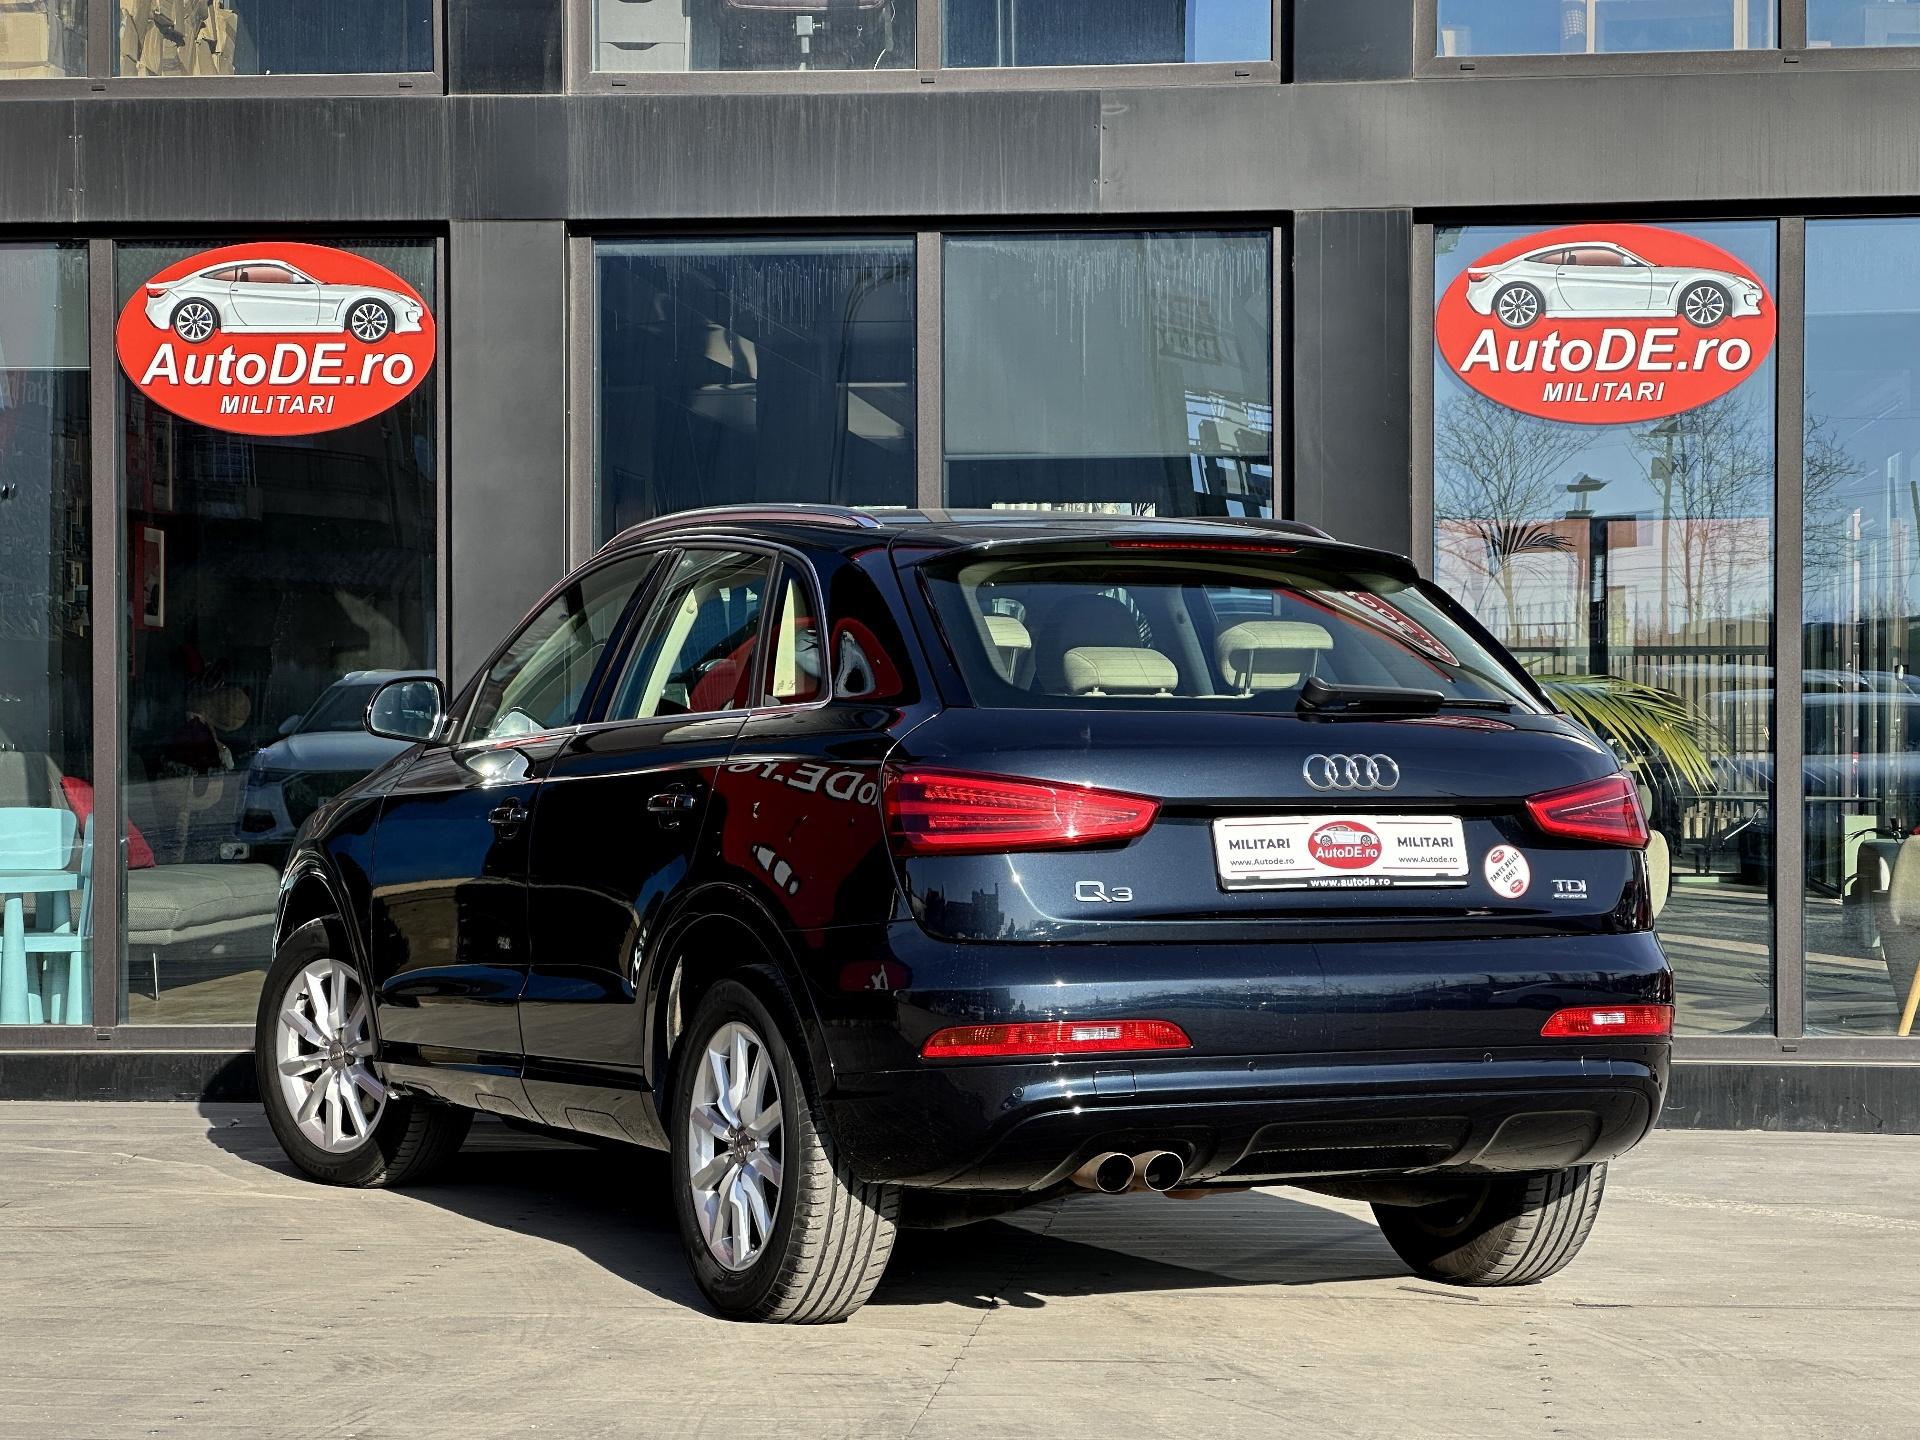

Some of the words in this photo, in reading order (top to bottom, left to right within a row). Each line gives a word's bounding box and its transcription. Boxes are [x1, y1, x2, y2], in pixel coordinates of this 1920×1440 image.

[1459, 327, 1751, 373] AutoDE.ro
[140, 343, 415, 386] AutoDE.ro
[1542, 381, 1665, 402] MILITARI
[219, 395, 334, 415] MILITARI
[1228, 838, 1291, 850] MILITARI
[1397, 836, 1454, 848] MILITARI
[1315, 846, 1379, 858] AutoDE.ro
[1230, 858, 1295, 866] www.Autode.ro
[1398, 855, 1458, 863] www.Autode.ro
[1310, 877, 1391, 887] www.autode.ro
[1552, 879, 1587, 893] TDI
[1075, 880, 1133, 903] Q3
